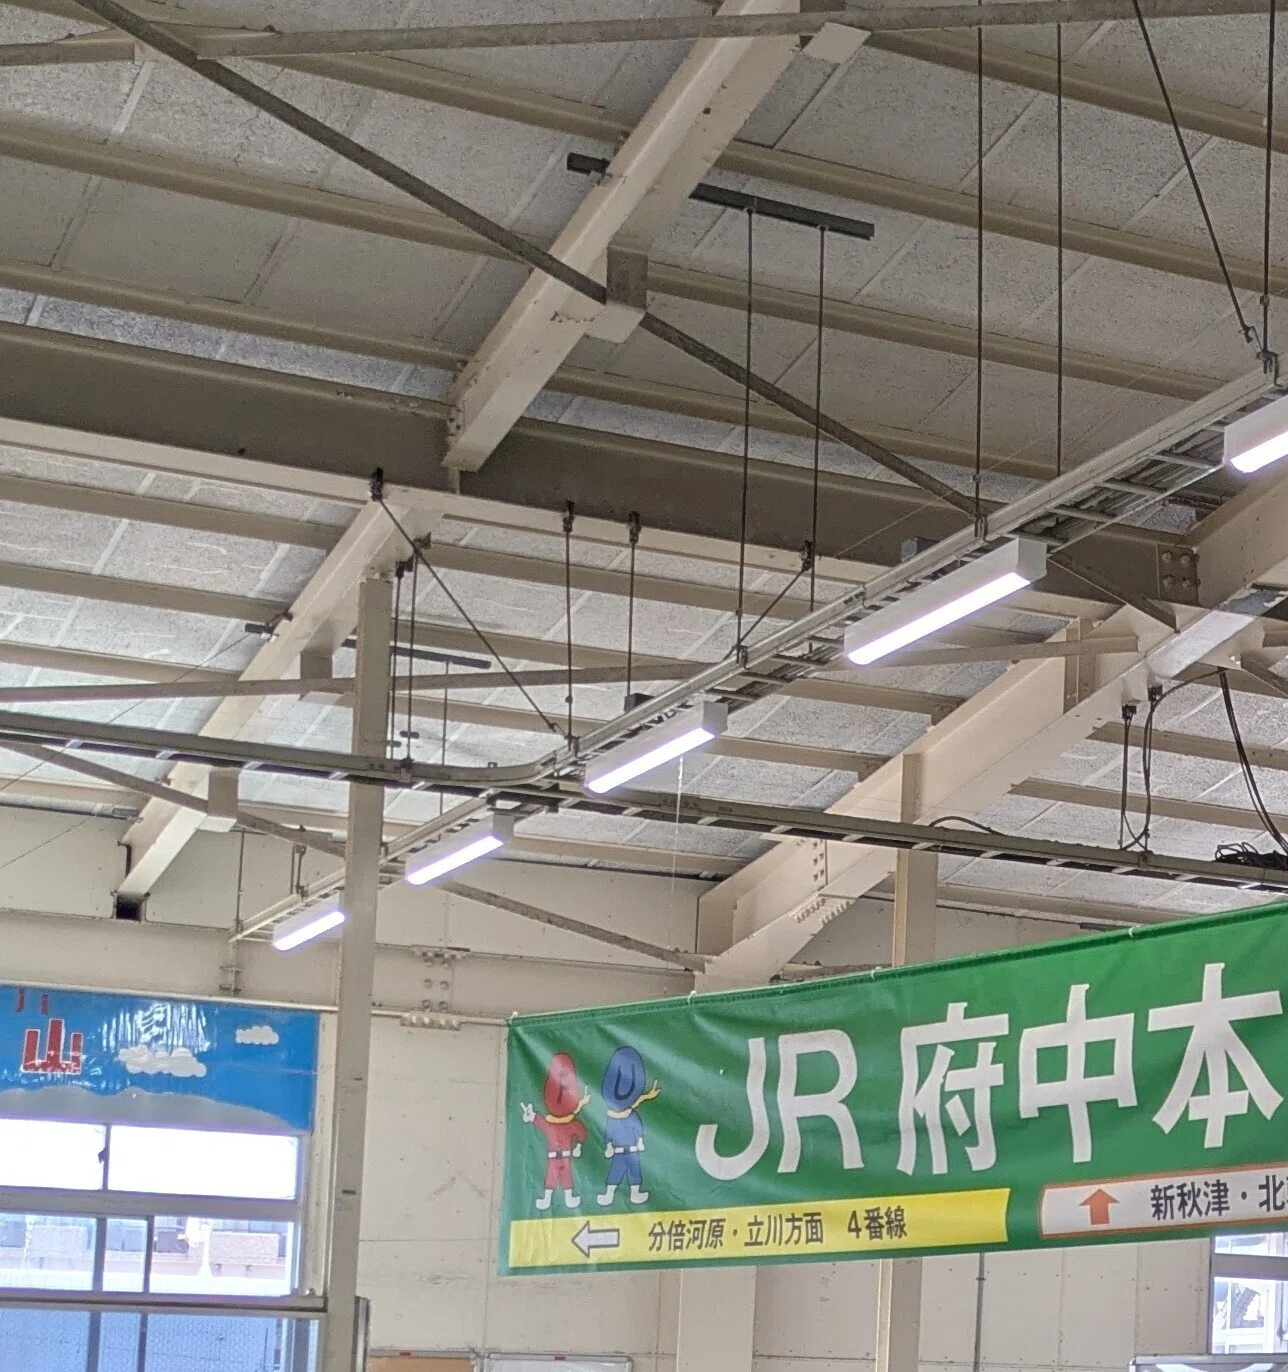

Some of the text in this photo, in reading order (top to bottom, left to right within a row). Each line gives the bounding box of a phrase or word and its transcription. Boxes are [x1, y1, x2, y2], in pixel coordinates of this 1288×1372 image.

[647, 1203, 908, 1254] 分倍河原・立川方面 4番線
